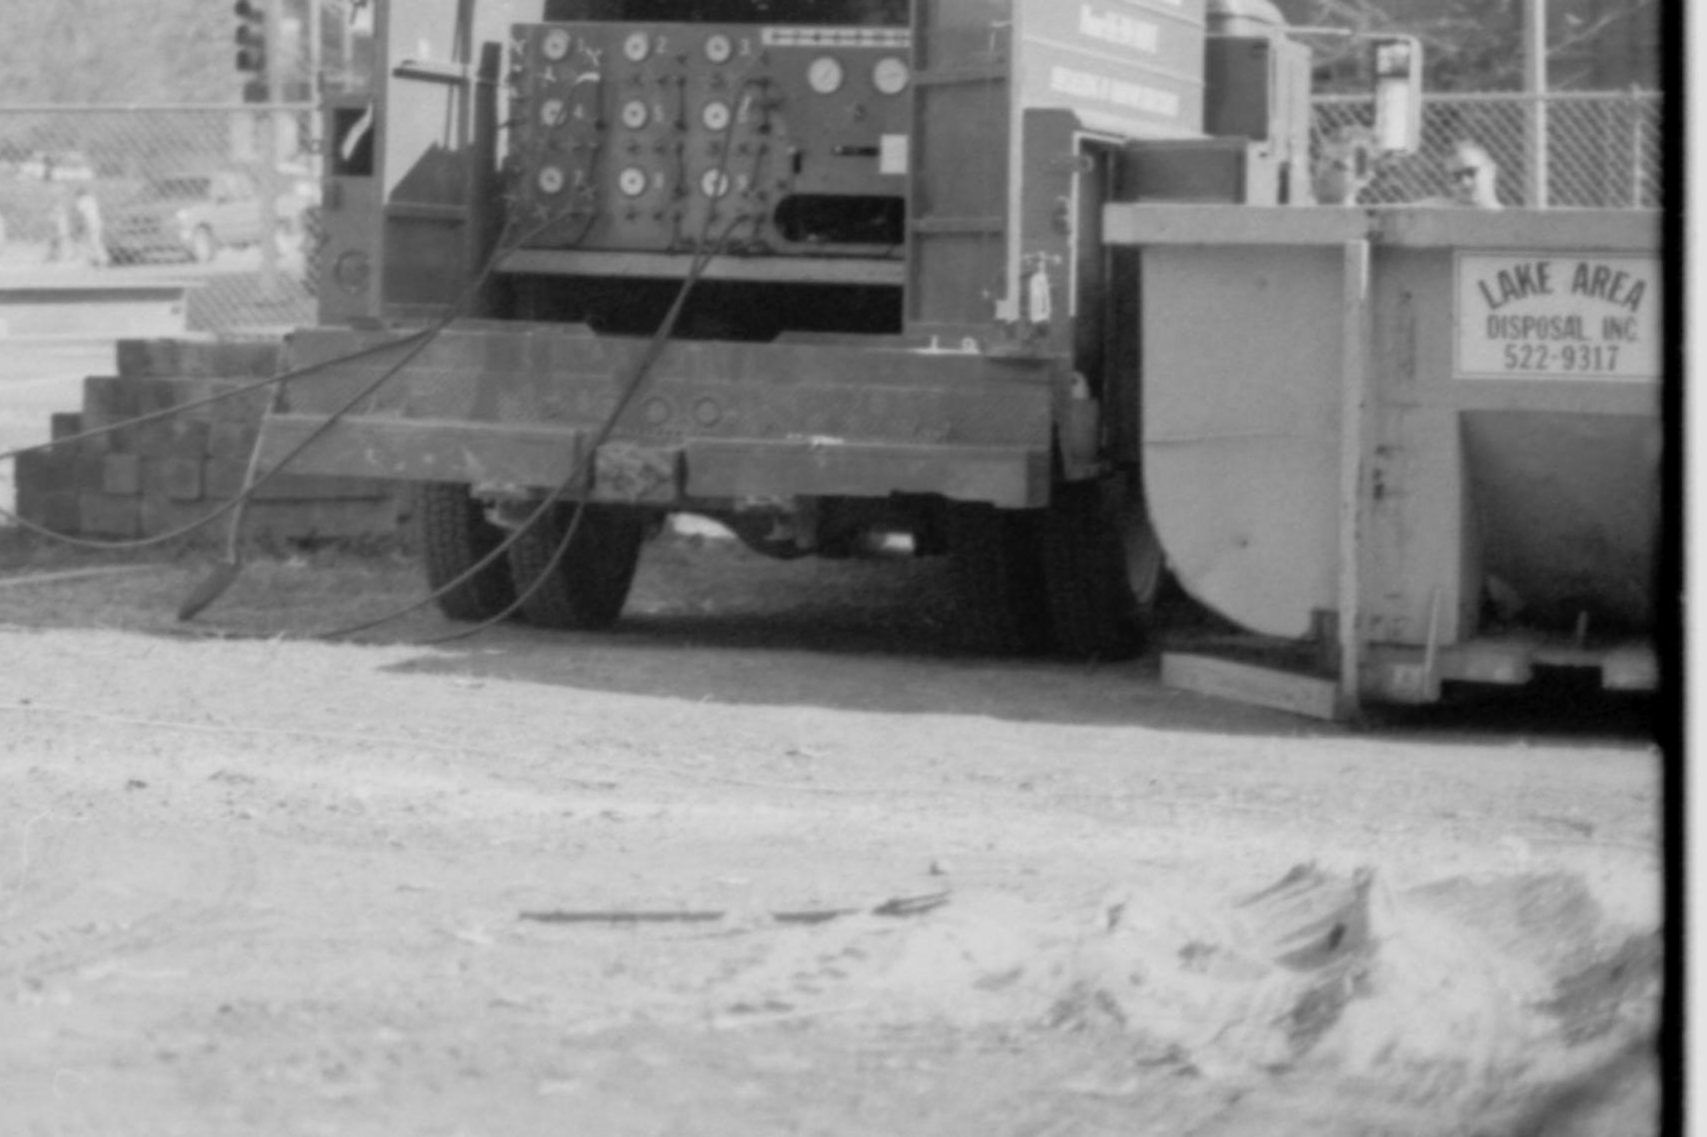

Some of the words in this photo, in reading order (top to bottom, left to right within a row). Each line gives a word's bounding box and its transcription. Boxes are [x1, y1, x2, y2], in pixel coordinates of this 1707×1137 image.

[1478, 261, 1553, 309] LAKE
[1571, 262, 1648, 312] AREA
[1504, 344, 1619, 372] 522-9317
